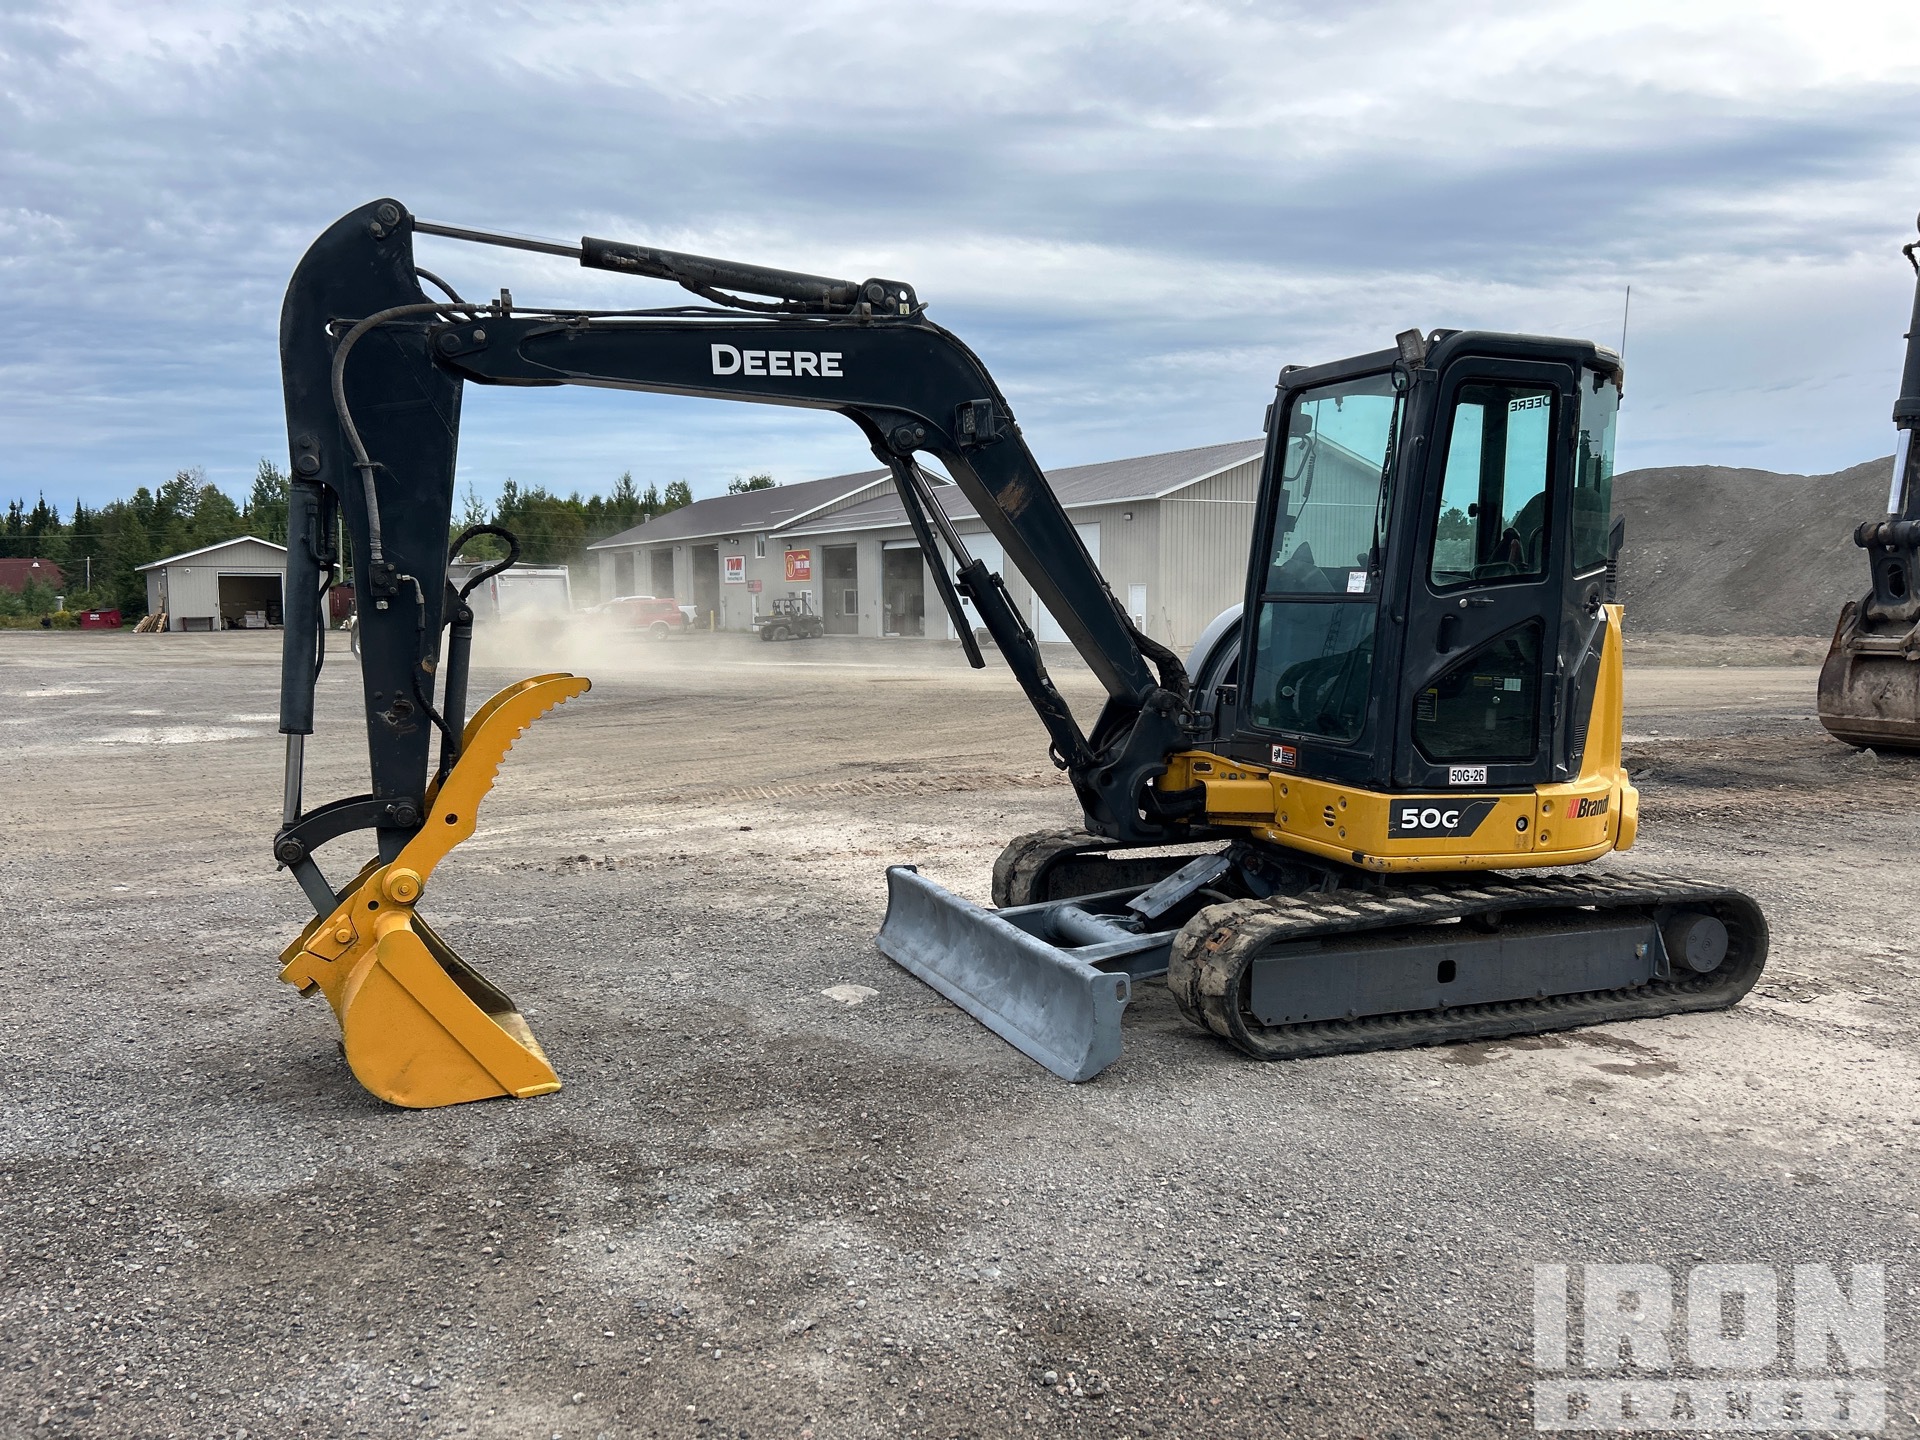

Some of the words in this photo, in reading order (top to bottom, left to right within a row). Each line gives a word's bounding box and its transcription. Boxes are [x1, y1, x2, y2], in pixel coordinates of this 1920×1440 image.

[711, 344, 843, 377] DEERE
[1451, 769, 1485, 782] 50G-26
[1577, 794, 1609, 818] Brand
[1401, 808, 1459, 829] 50G
